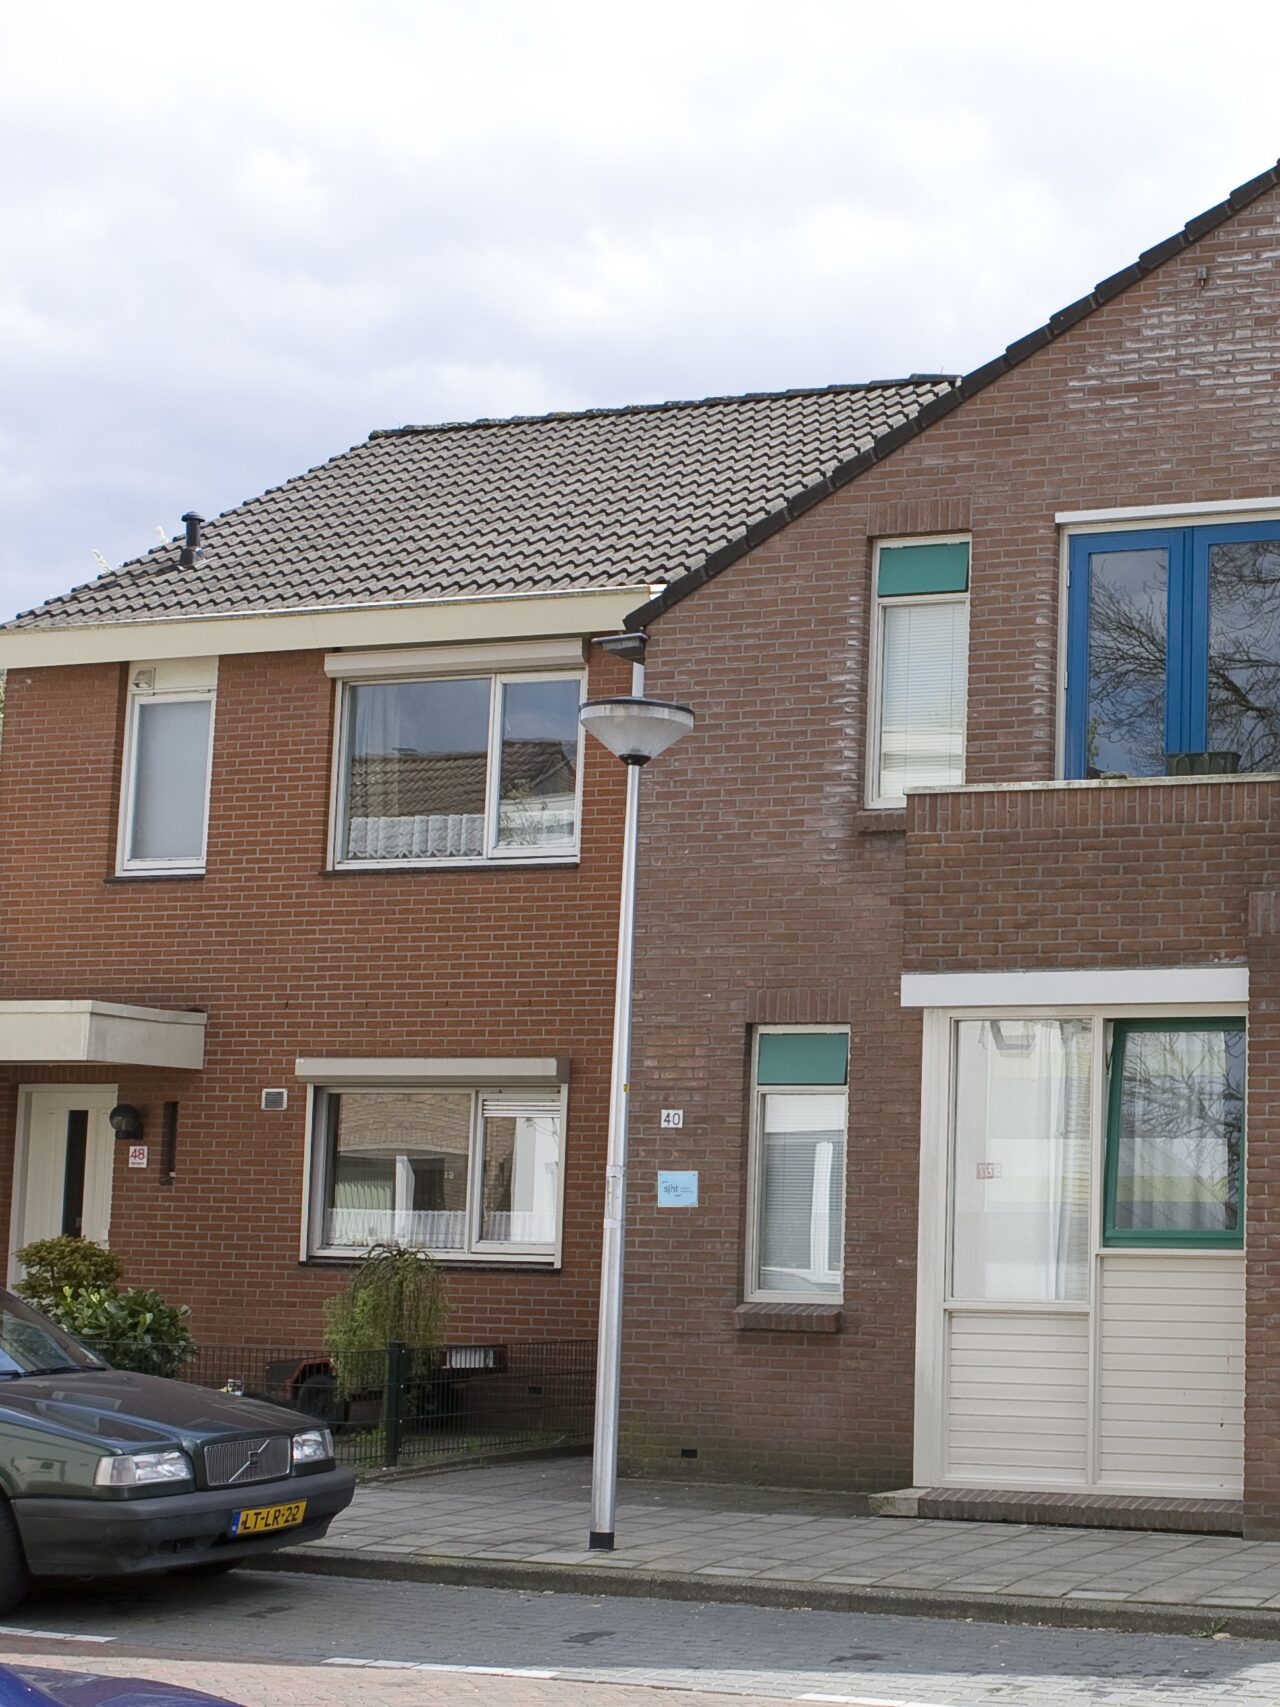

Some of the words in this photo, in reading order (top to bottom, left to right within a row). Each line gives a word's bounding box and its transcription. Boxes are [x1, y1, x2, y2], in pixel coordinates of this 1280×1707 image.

[664, 1112, 681, 1126] 40
[130, 1148, 145, 1160] 48
[242, 1505, 300, 1530] LT-LR-22
